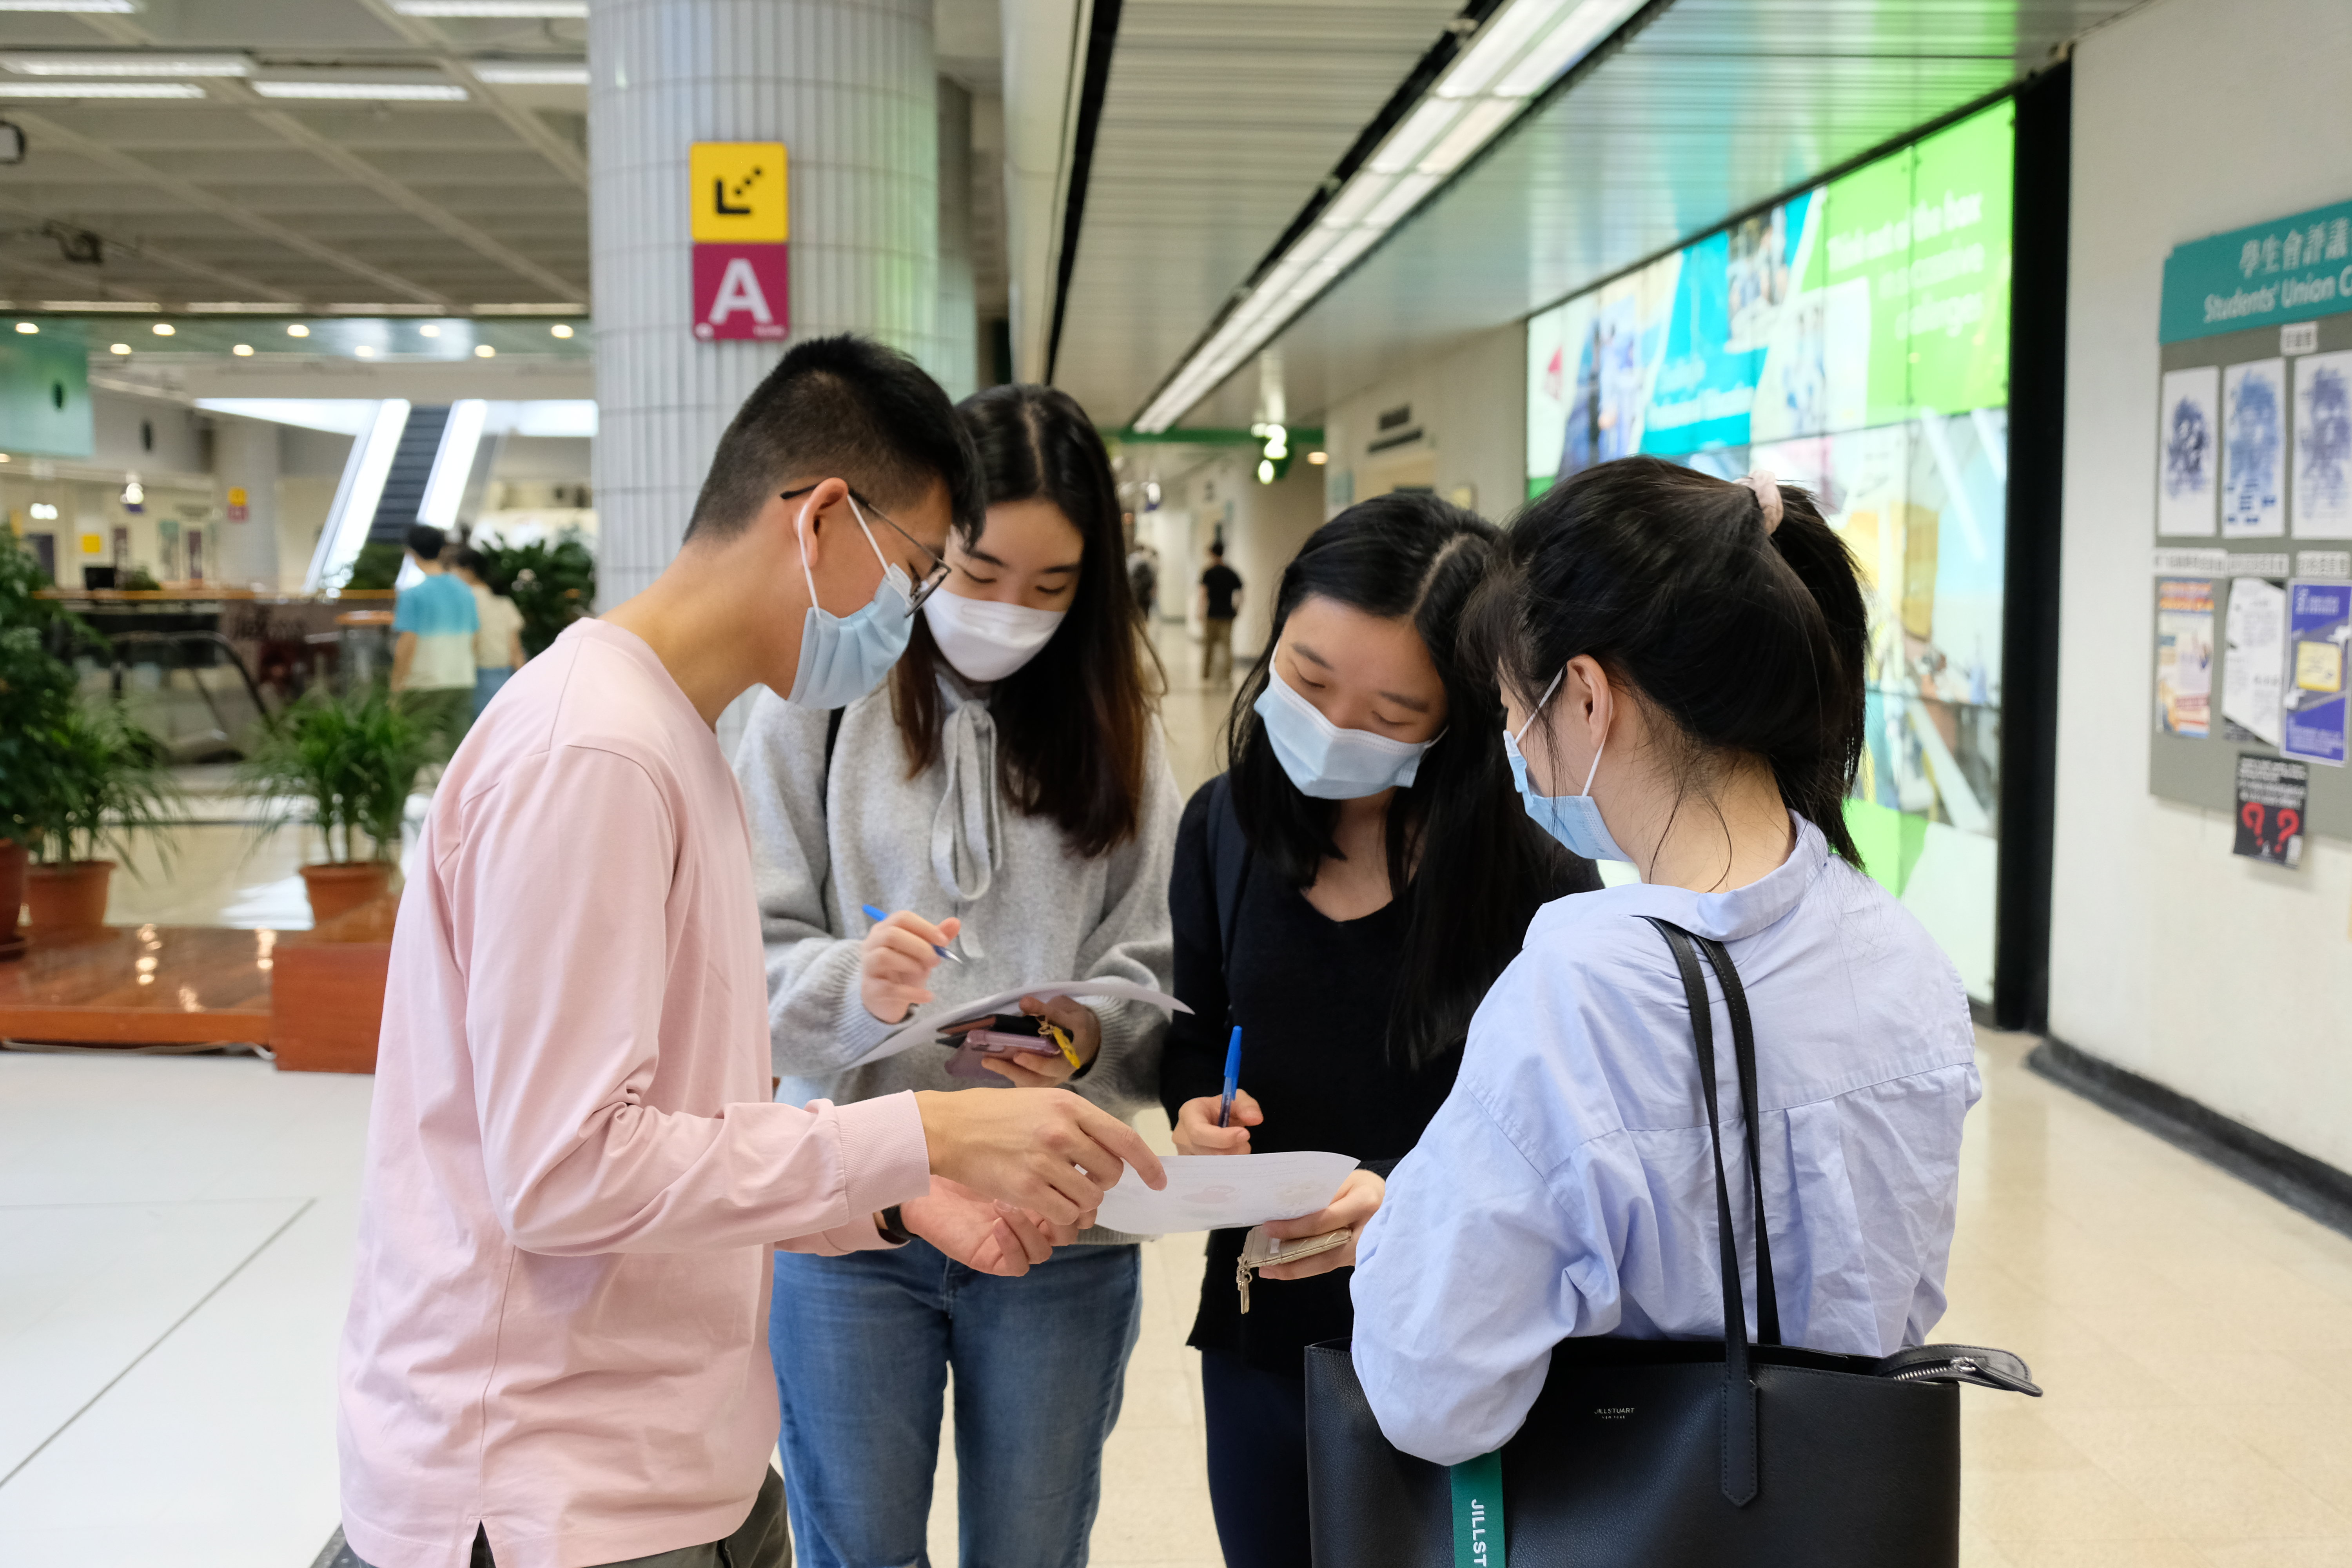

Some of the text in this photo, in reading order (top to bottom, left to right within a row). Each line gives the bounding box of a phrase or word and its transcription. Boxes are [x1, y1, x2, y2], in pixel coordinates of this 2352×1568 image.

[2239, 217, 2352, 278] 學生會評議
[708, 258, 772, 325] A
[2203, 282, 2279, 323] Students'
[2281, 273, 2335, 308] Union
[1471, 1499, 1486, 1567] JILLST
